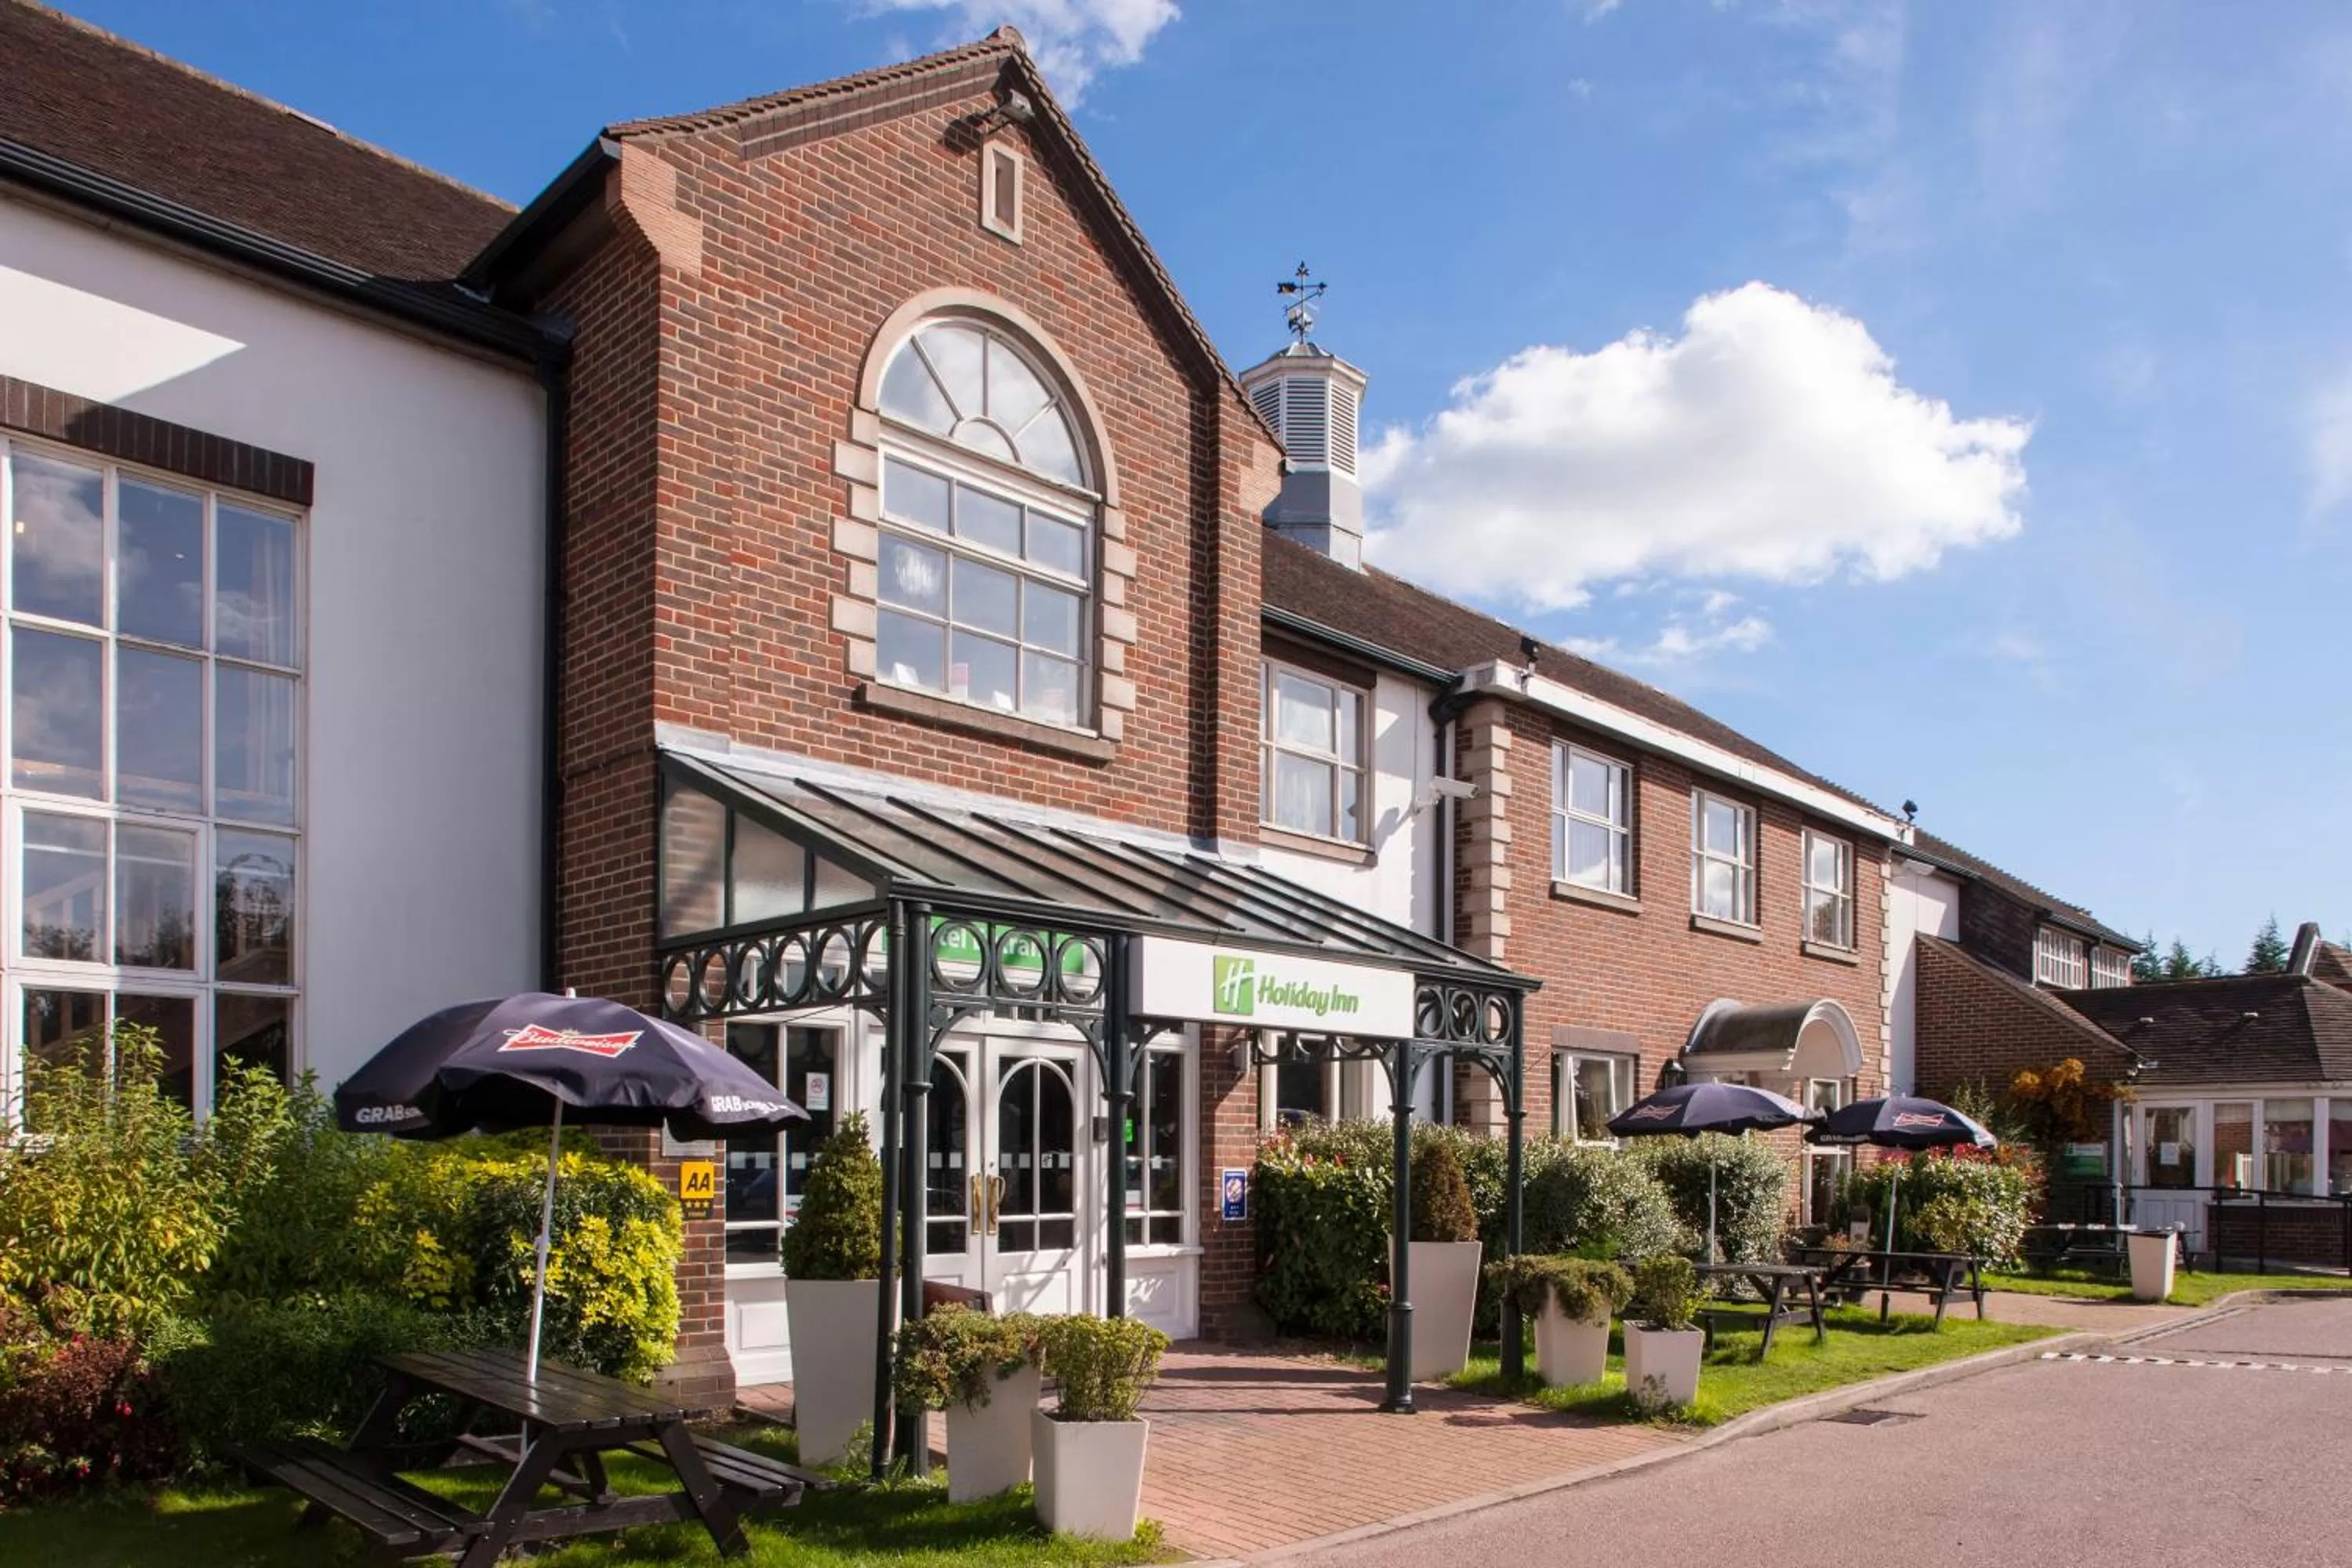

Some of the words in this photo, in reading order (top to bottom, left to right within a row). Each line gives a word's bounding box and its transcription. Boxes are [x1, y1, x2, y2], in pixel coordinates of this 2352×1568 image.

[1258, 975, 1330, 1016] Holiday
[1330, 984, 1359, 1014] Inn
[502, 1028, 637, 1051] Budweiser
[686, 1172, 710, 1192] AA
